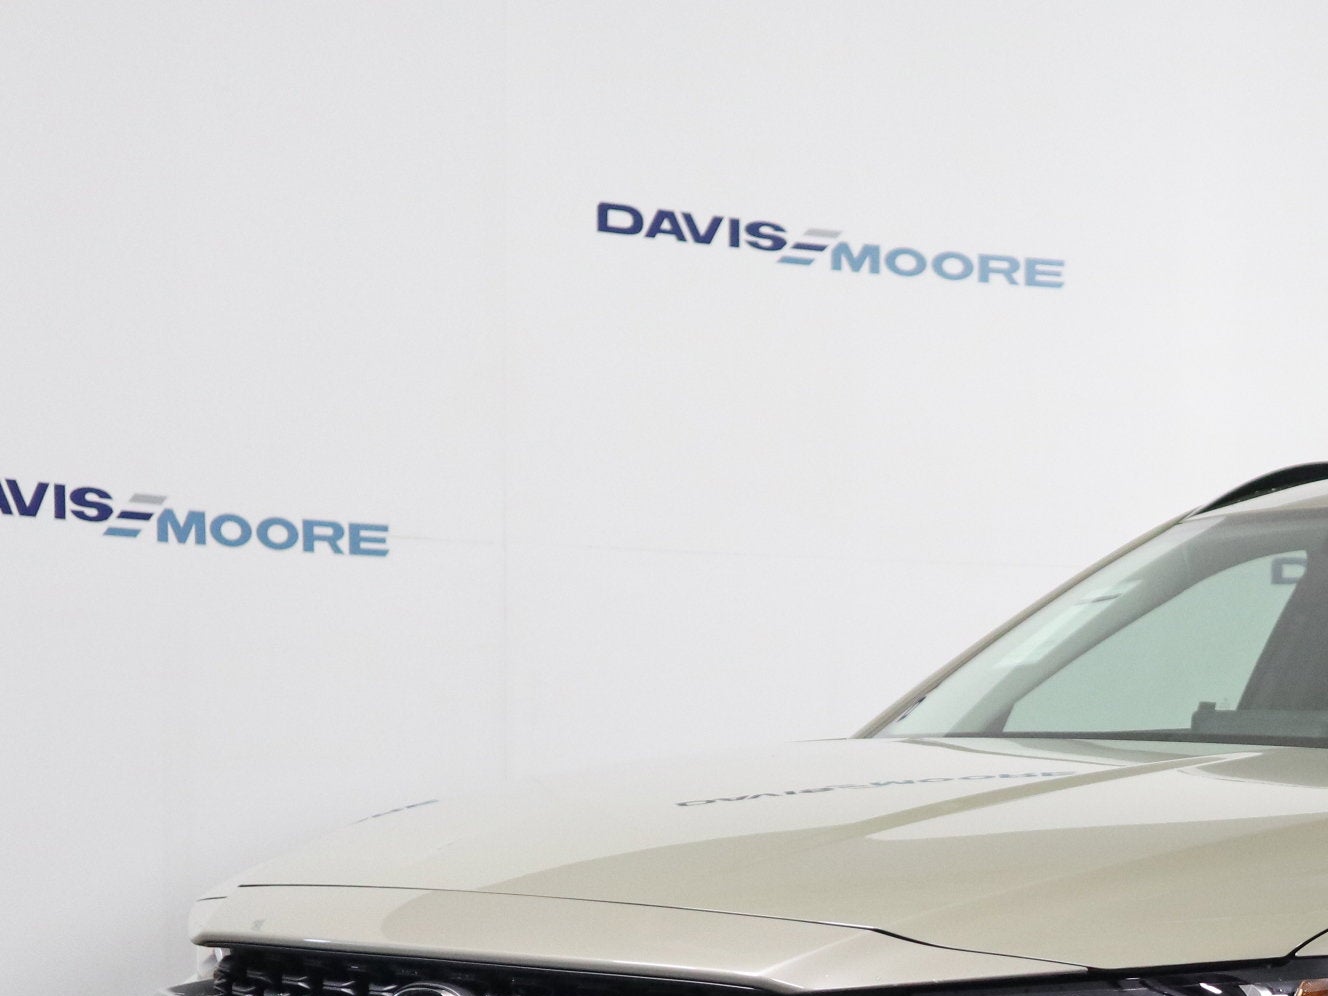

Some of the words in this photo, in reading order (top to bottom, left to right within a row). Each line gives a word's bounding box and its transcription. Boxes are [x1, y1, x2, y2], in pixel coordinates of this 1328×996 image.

[596, 201, 788, 252] DAVIS
[829, 241, 1066, 289] MOORE
[156, 507, 390, 558] MOORE
